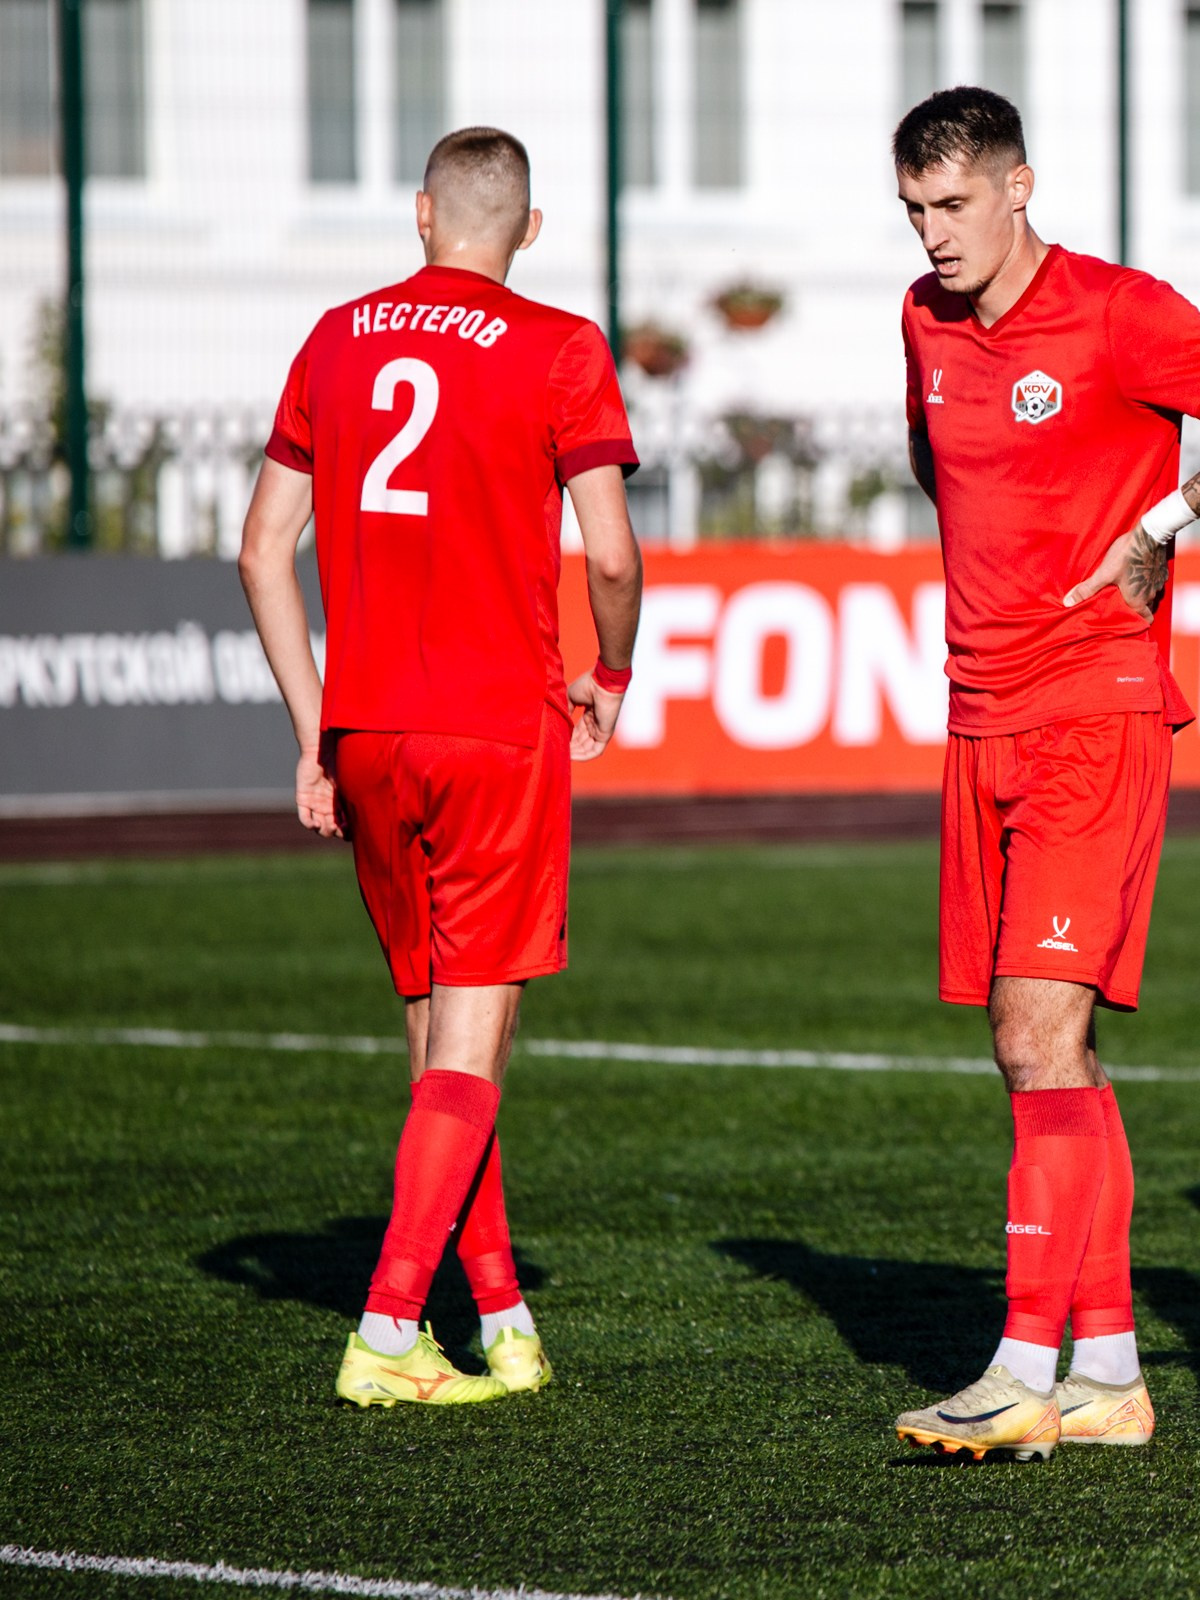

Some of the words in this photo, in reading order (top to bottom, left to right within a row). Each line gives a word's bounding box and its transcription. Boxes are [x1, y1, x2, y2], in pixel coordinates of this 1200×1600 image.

[353, 302, 508, 348] НЕСТЕРОВ
[1024, 385, 1050, 394] KDV
[360, 357, 440, 516] 2
[1036, 938, 1079, 953] JÖGEL
